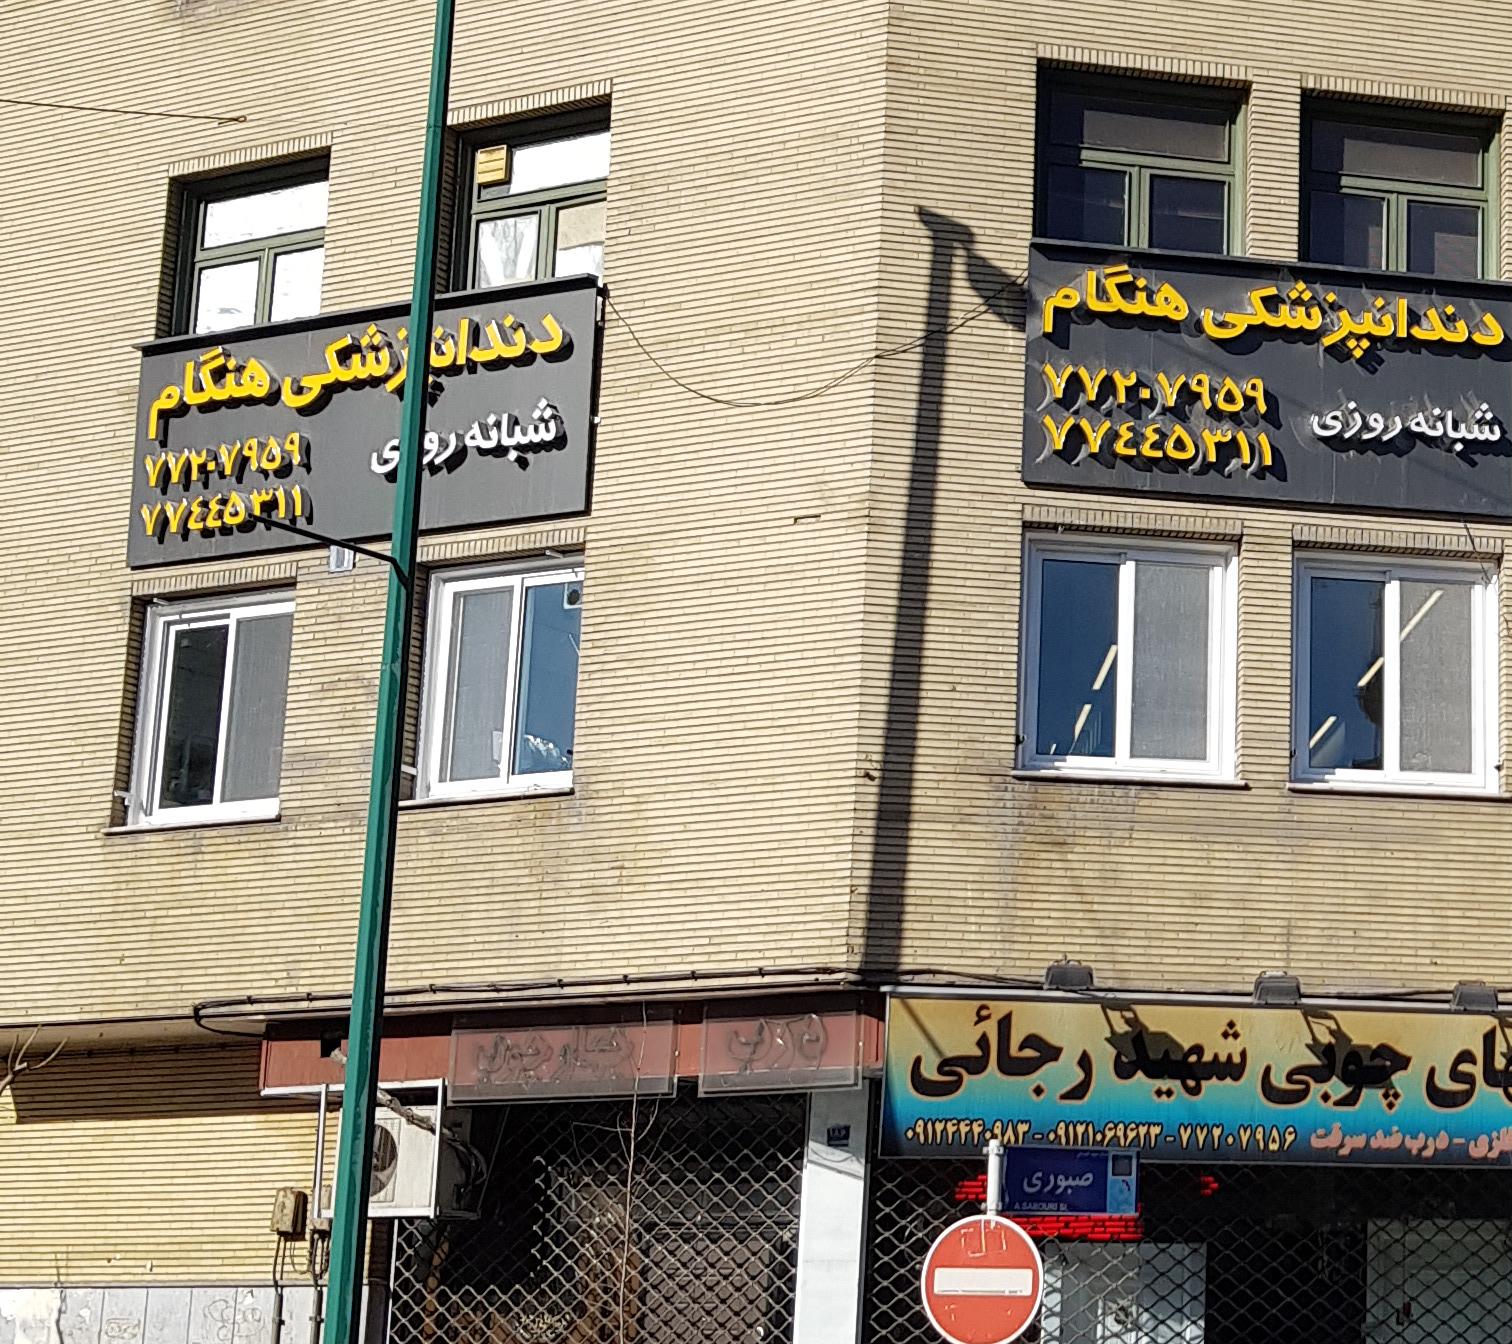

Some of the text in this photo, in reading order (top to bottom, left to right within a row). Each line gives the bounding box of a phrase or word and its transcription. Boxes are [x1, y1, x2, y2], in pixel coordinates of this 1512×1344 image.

[1042, 264, 1505, 359] دندانپزشکی هنگام
[148, 313, 564, 440] دندانزشکی هنگام
[370, 397, 556, 475] شبانه روی
[1411, 403, 1502, 453] شبانه
[910, 1003, 1094, 1101] رجائی
[1112, 1019, 1248, 1098] شهید
[1260, 1040, 1413, 1111] چوبی
[1022, 1170, 1094, 1195] صبوری
